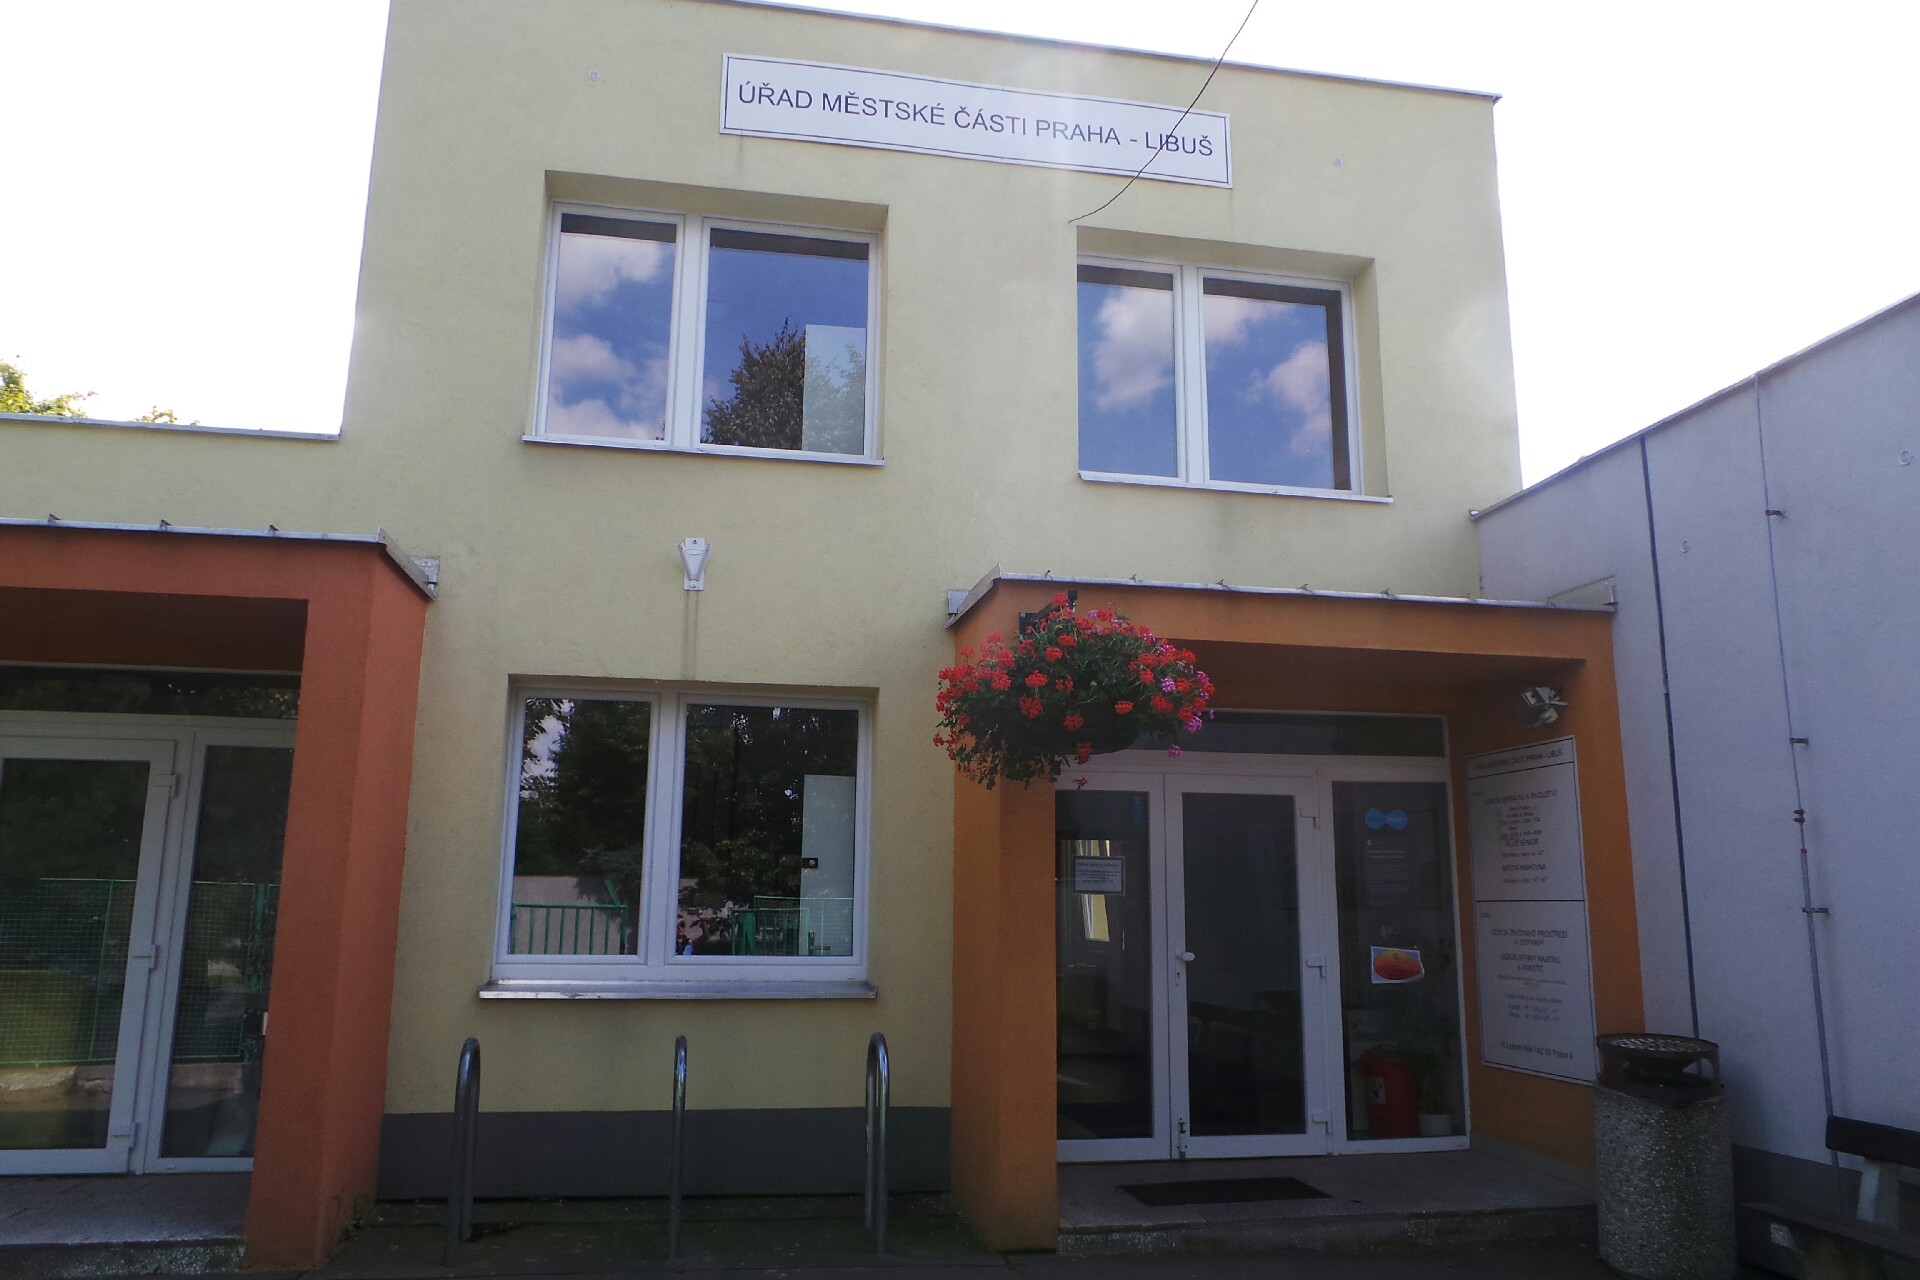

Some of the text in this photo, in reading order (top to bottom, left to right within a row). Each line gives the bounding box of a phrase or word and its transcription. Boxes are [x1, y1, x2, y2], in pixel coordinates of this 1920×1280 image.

[738, 81, 813, 109] ÚŘAD
[821, 91, 945, 126] MĚSTSKÉ
[953, 105, 1027, 136] ČÁSTI
[1035, 119, 1121, 146] PRAHA
[1145, 130, 1213, 157] LIBUŠ
